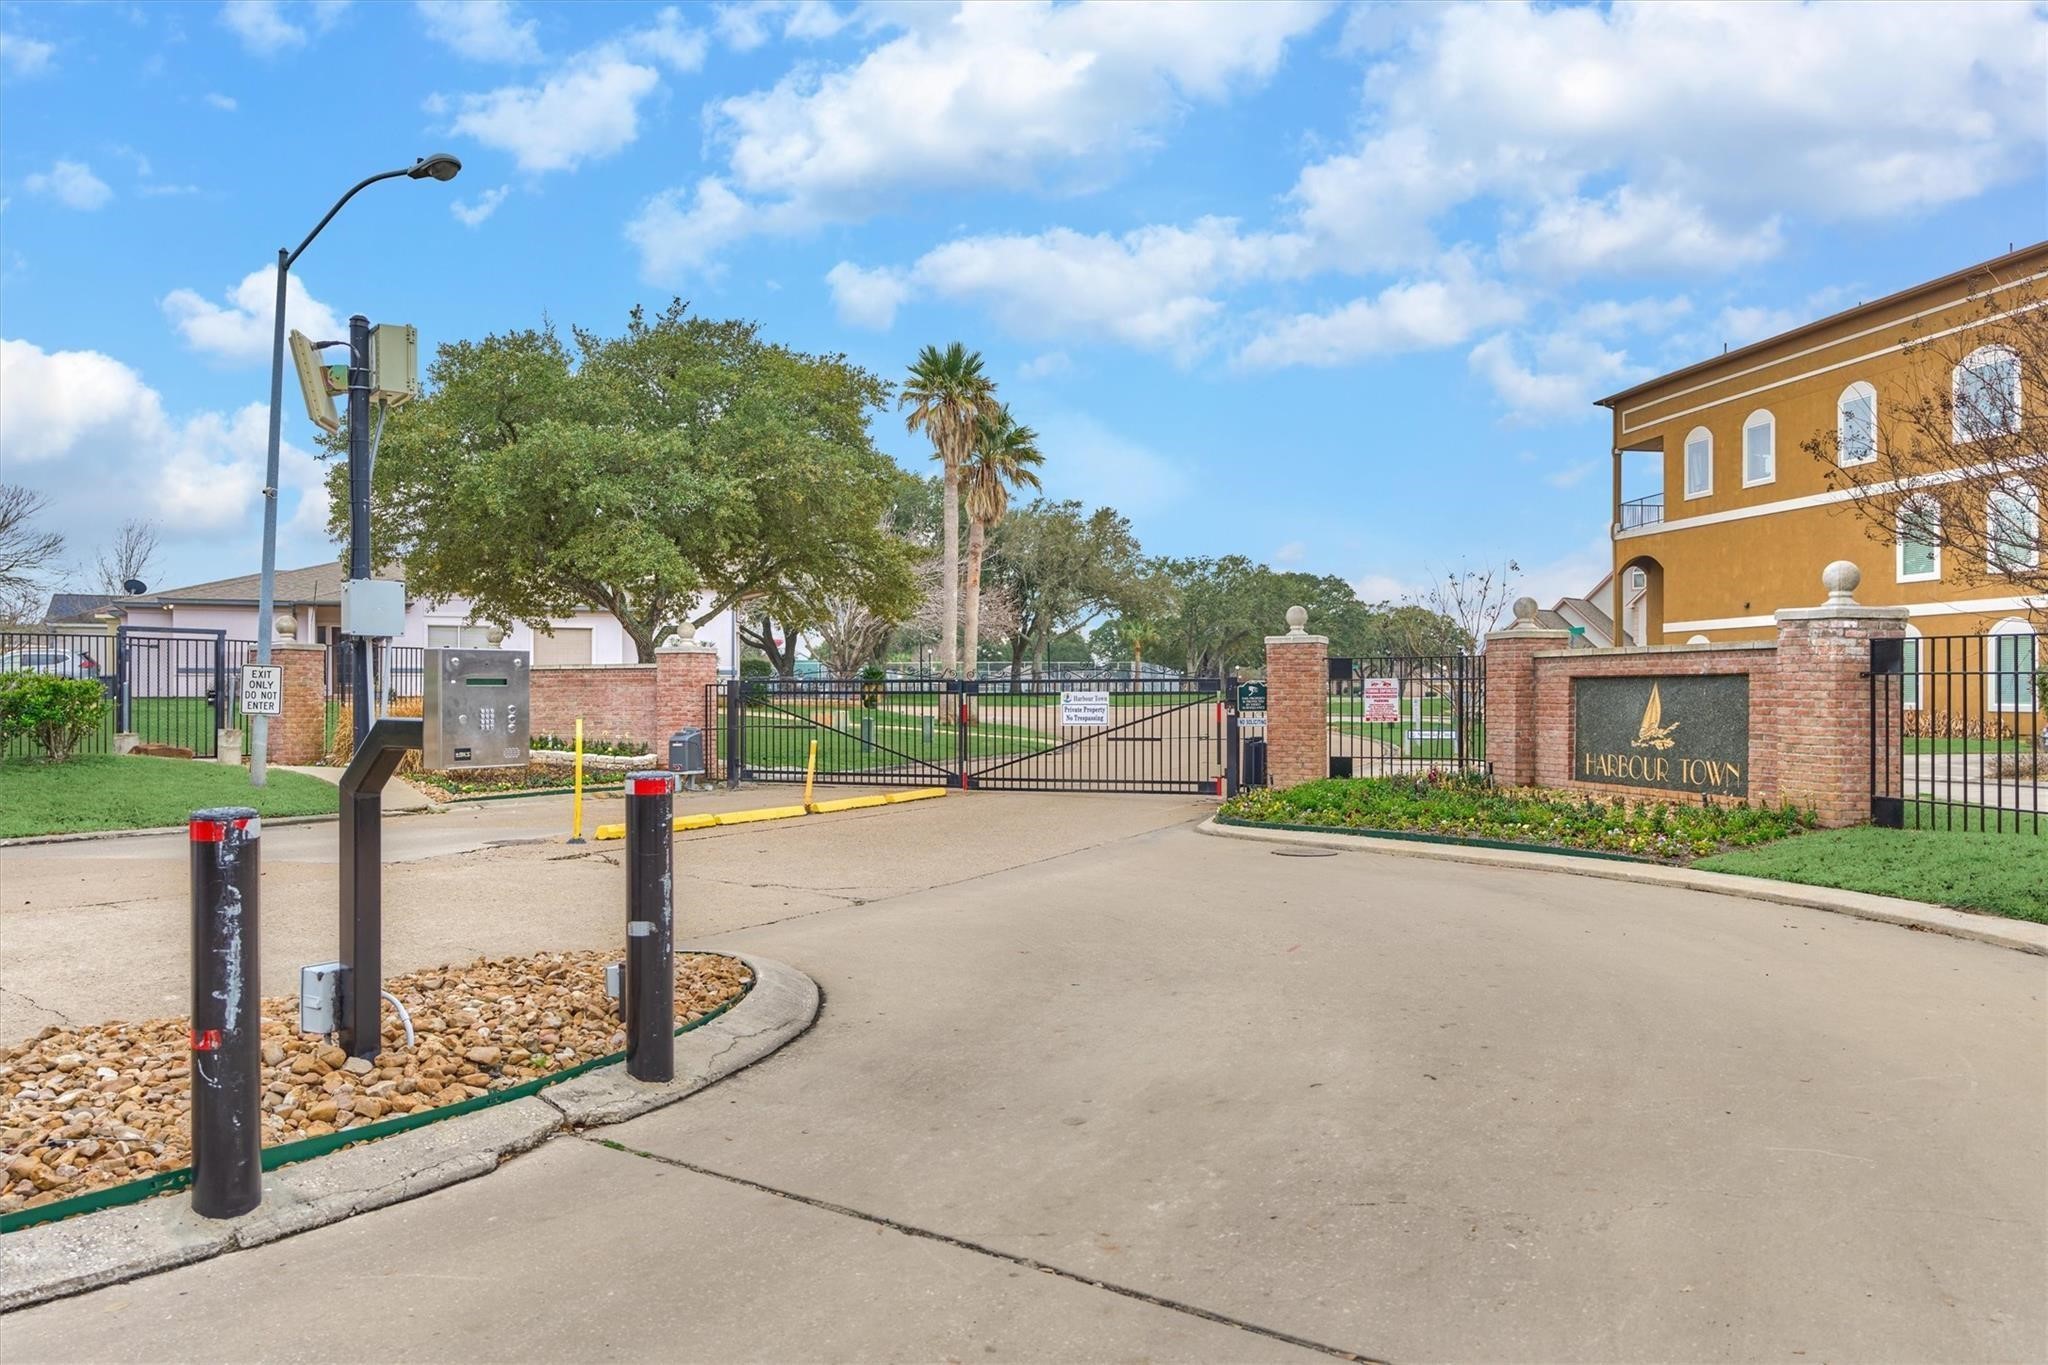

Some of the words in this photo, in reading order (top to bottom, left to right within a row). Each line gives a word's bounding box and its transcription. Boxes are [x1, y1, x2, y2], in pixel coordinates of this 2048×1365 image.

[252, 670, 272, 678] EXIT
[249, 680, 274, 689] ONLY
[245, 690, 256, 699] DO
[260, 691, 277, 700] NOT
[248, 701, 274, 710] ENTER
[1585, 752, 1669, 782] HARBOUR
[1680, 758, 1740, 788] TOWN
